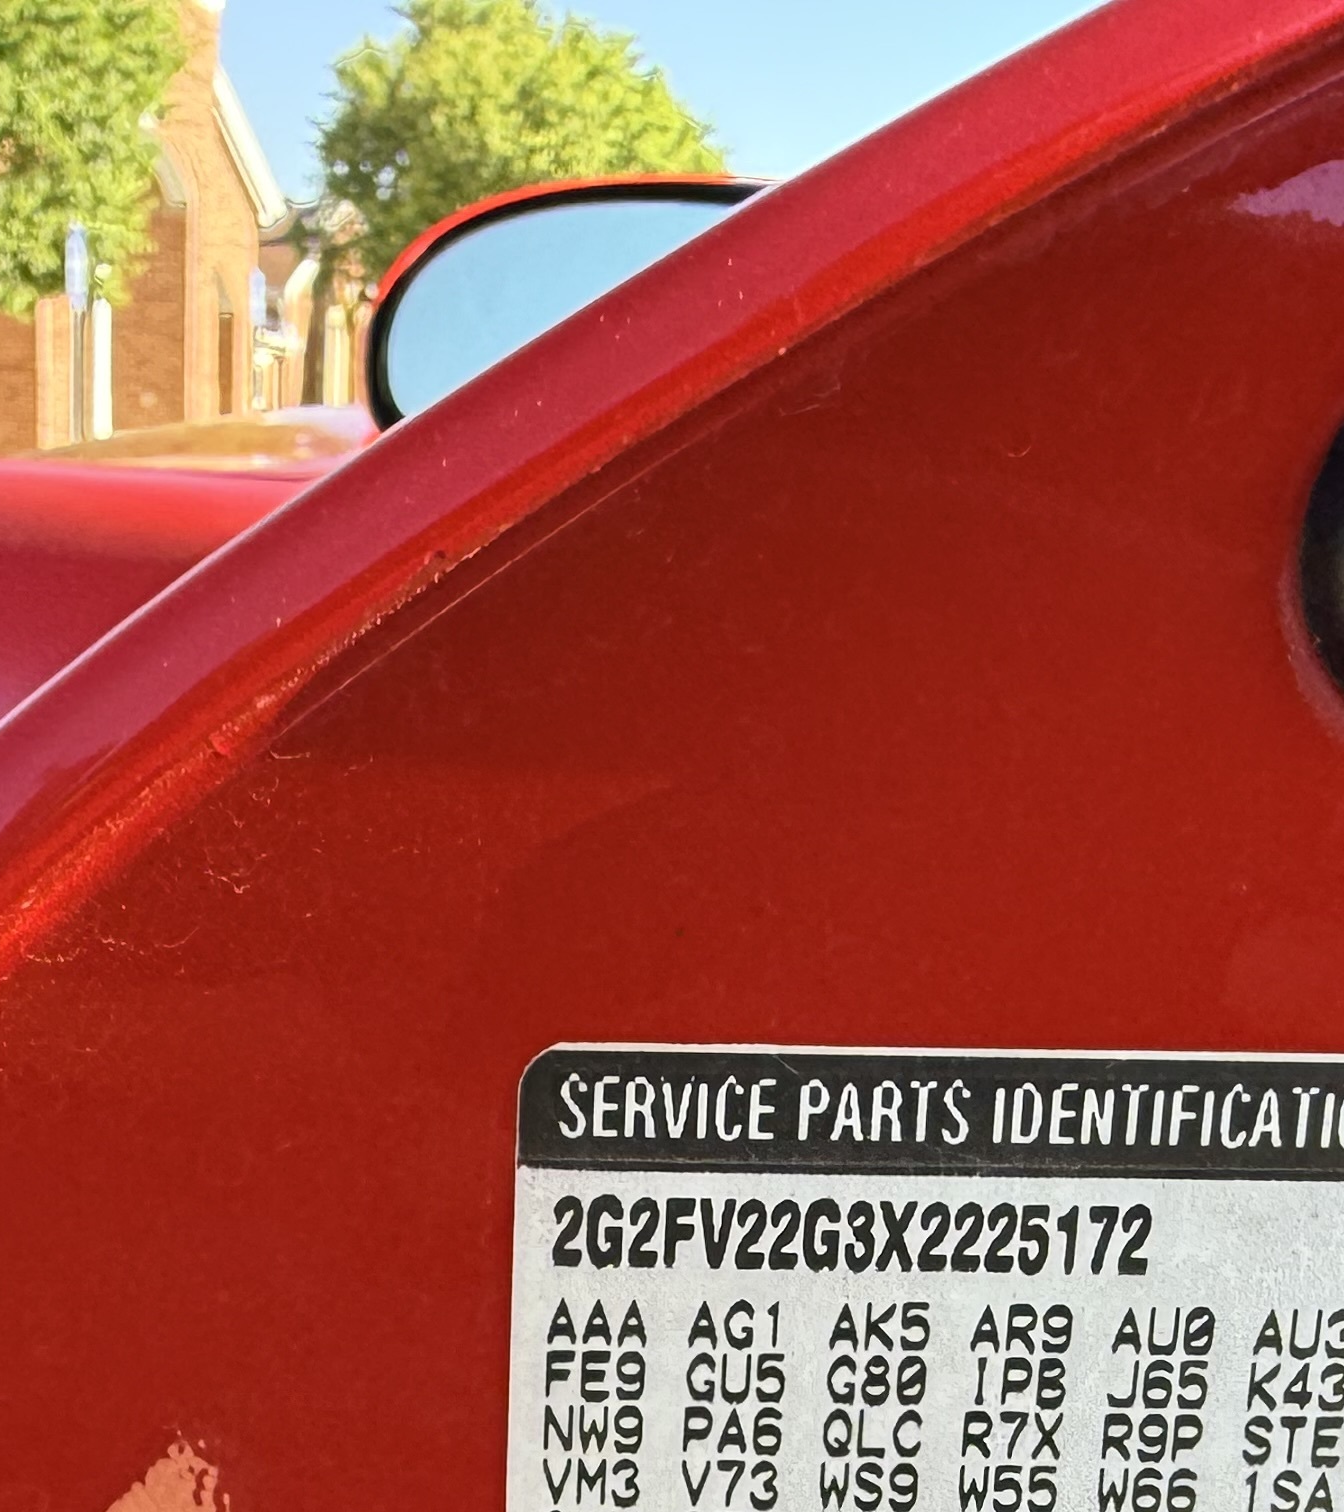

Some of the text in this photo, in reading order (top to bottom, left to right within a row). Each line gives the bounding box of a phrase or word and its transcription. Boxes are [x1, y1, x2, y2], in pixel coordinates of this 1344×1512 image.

[559, 1073, 776, 1141] SERVICE
[798, 1079, 970, 1144] PARTS
[553, 1194, 1152, 1275] 2G2FV22G3X2225172
[548, 1298, 646, 1347] AAA
[688, 1299, 779, 1350] AG1
[830, 1302, 930, 1352] AK5
[971, 1304, 1073, 1354] AR9
[1112, 1307, 1215, 1355] AU0
[546, 1350, 645, 1402] FE9
[687, 1353, 785, 1404] GU5
[827, 1355, 926, 1407] G80
[1107, 1360, 1208, 1409] J65
[544, 1405, 643, 1453] NW9
[683, 1407, 782, 1456] PA6
[823, 1409, 922, 1458] QLC
[962, 1411, 1063, 1459] R7X
[1102, 1414, 1203, 1463] R9P
[1243, 1416, 1344, 1468] STE
[543, 1459, 639, 1508] VM3
[682, 1460, 778, 1511] V73
[820, 1462, 918, 1512] WS9
